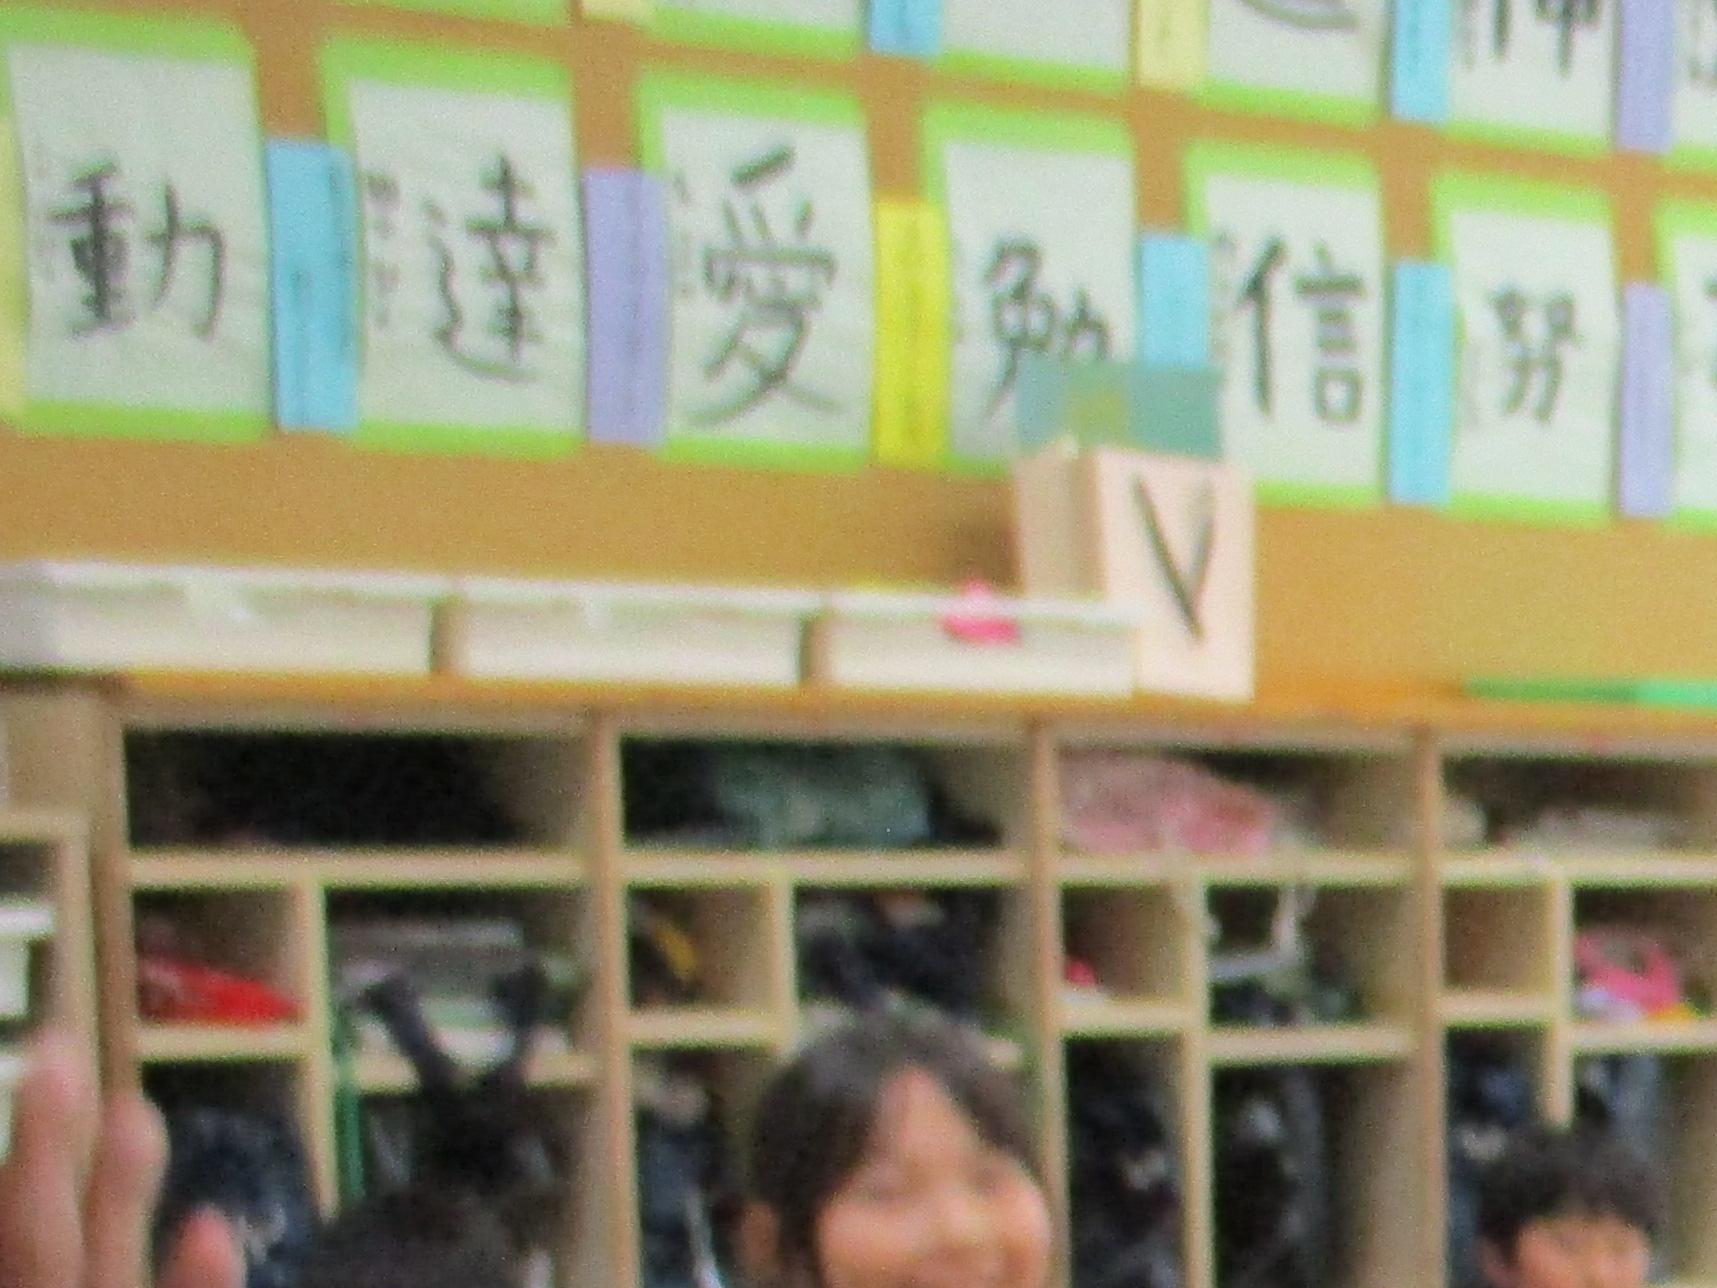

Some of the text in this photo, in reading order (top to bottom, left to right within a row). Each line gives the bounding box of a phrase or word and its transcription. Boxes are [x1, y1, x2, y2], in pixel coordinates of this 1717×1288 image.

[46, 160, 226, 342] 動
[425, 150, 560, 382] 達
[686, 142, 840, 428] 愛
[1236, 236, 1366, 424] 信
[1488, 284, 1582, 426] 努
